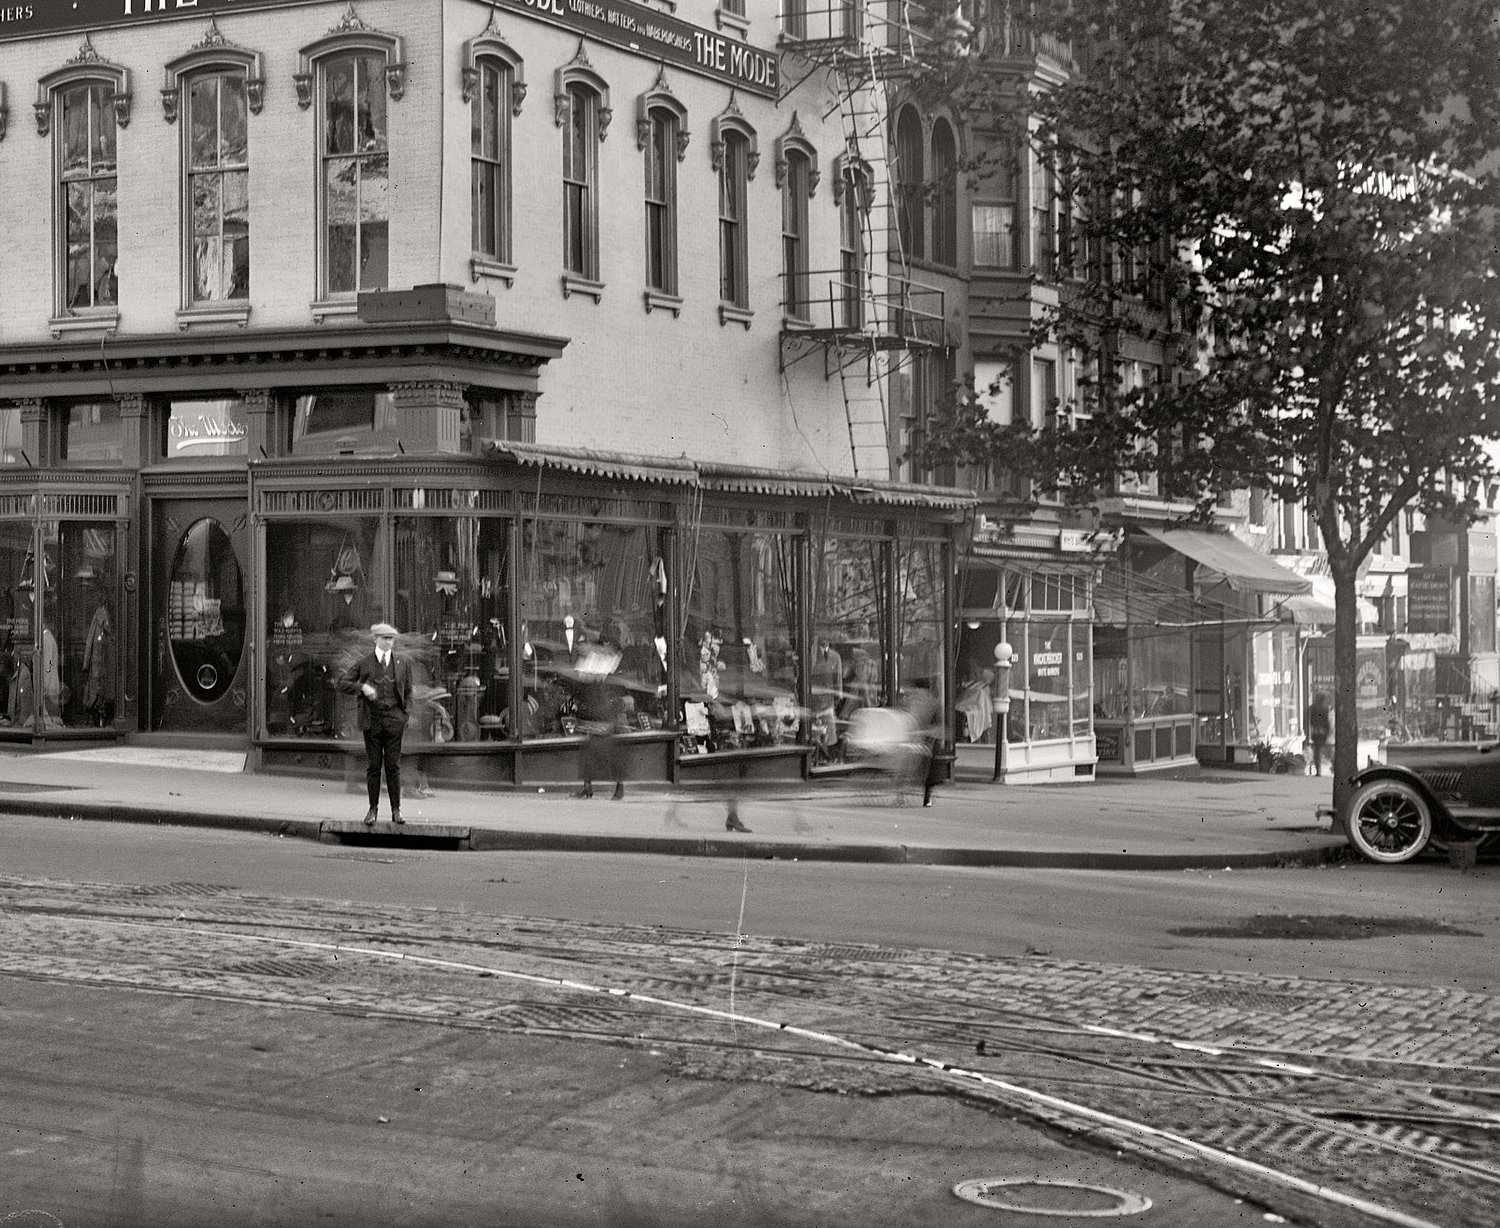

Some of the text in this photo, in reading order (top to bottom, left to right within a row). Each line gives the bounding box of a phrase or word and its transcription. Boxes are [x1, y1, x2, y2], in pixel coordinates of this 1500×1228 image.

[607, 9, 637, 32] HATTERS
[693, 32, 726, 71] THE
[731, 44, 777, 88] MODE
